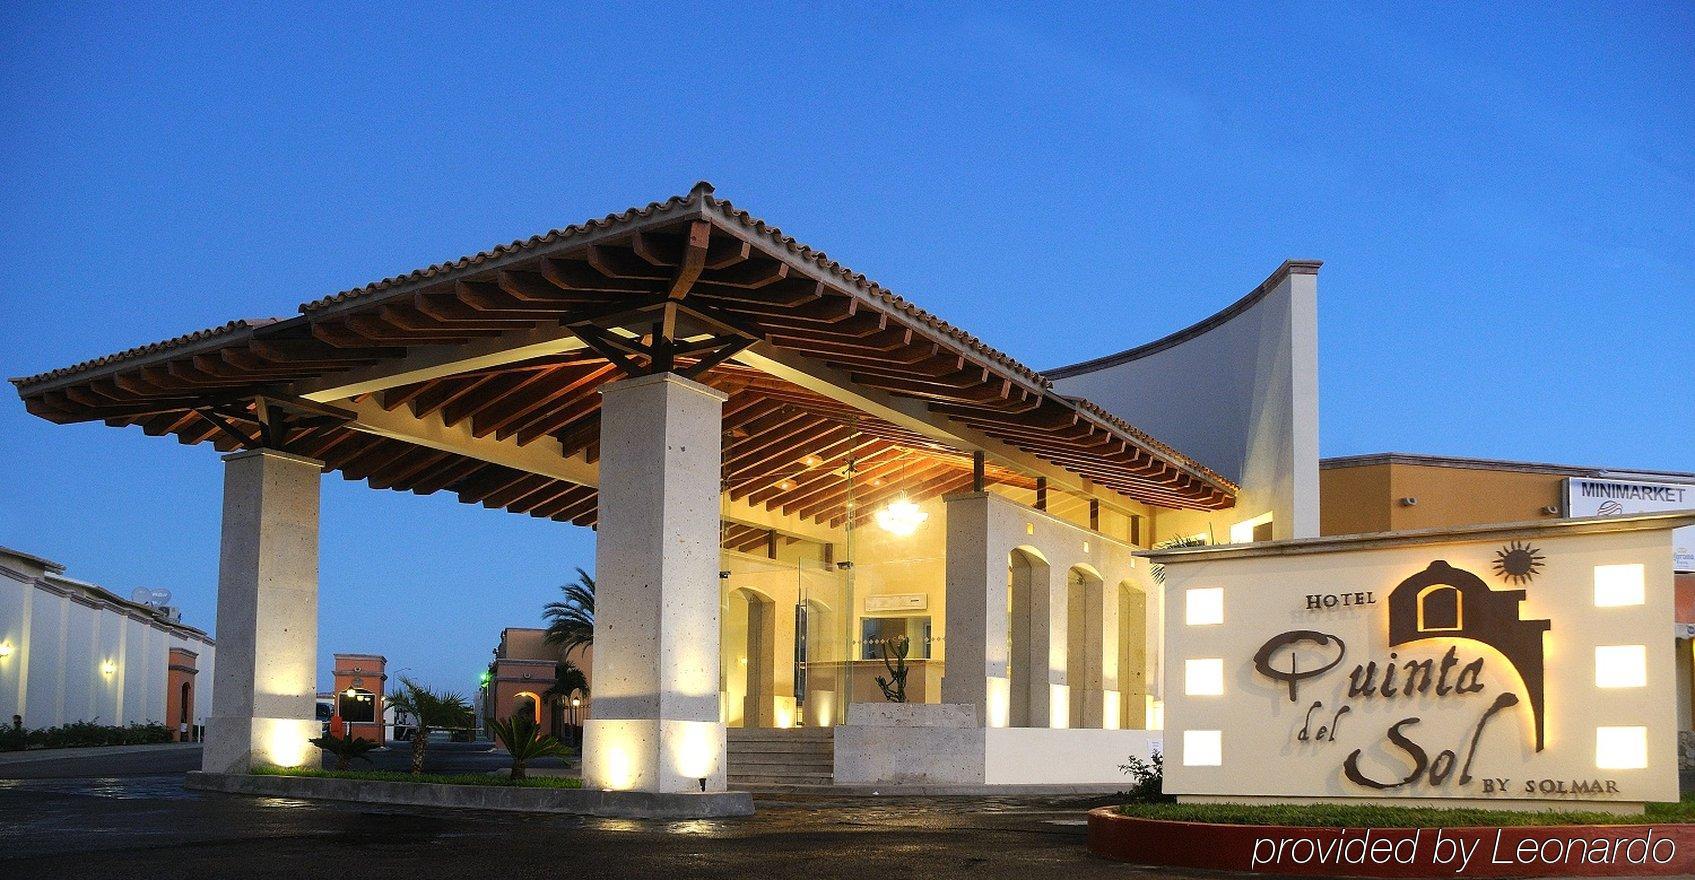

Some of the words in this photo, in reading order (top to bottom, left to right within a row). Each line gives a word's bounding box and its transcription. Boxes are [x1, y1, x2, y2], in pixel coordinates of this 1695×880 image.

[1581, 482, 1686, 502] MINIMARKET
[1305, 591, 1377, 610] HOTEL
[1253, 629, 1485, 702] Quinta
[1297, 701, 1350, 742] del
[1343, 692, 1519, 789] Sol
[1482, 778, 1510, 793] BY
[1525, 778, 1620, 794] SOLMAR
